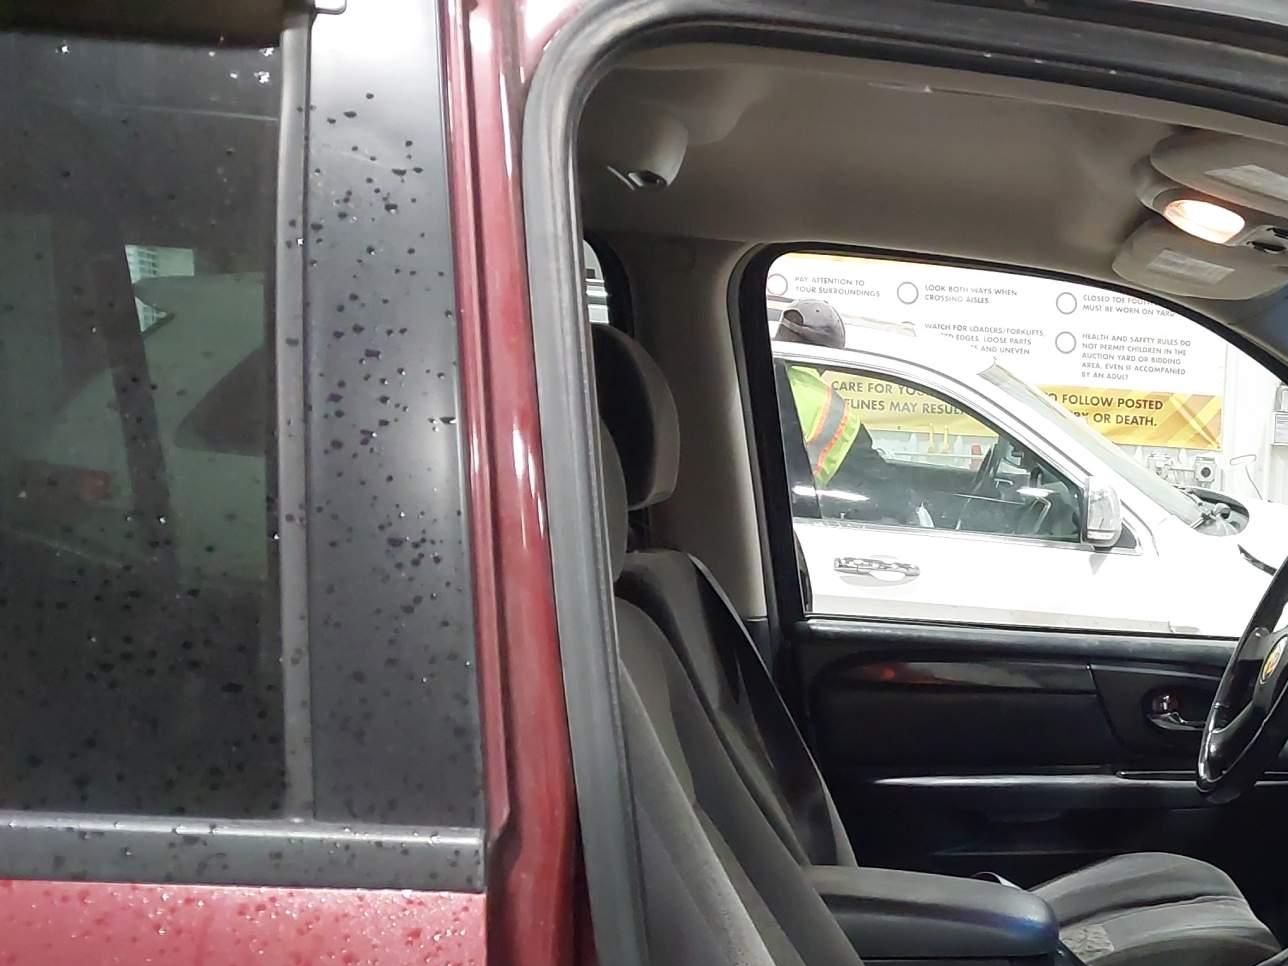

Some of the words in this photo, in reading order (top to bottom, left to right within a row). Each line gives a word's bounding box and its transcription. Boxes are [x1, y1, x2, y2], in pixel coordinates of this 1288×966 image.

[811, 277, 853, 286] ATTENTION
[818, 287, 881, 297] SURROUNDINGS
[924, 284, 946, 292] LOOK
[948, 285, 969, 293] BOTH
[970, 287, 992, 295] WAYS
[994, 288, 1018, 296] WHEN
[924, 294, 963, 303] CROSSING
[1082, 294, 1110, 302] CLOSED
[1082, 304, 1102, 312] MUST
[1115, 306, 1140, 314] WORN
[924, 322, 951, 331] WATCH
[952, 324, 967, 332] FOR
[983, 336, 1008, 344] LOOSE
[1009, 337, 1032, 345] PARTS
[1082, 333, 1109, 341] HEALTH
[1130, 336, 1155, 344] SAFETY
[1157, 338, 1178, 346] RULES
[981, 345, 998, 353] AND
[1000, 346, 1030, 355] UNEVEN
[1100, 343, 1125, 351] PERMIT
[1127, 346, 1161, 354] CHILDREN
[1175, 348, 1187, 356] THE
[1082, 352, 1115, 360] AUCTION
[1117, 354, 1136, 362] YARD
[1151, 357, 1181, 365] BIDDING
[1105, 363, 1124, 371] EVEN
[1134, 365, 1186, 375] ACCOMPANIED
[831, 380, 863, 392] CARE
[868, 382, 893, 394] FOR
[889, 400, 918, 413] MAY
[1062, 393, 1114, 407] FOLLOW
[1117, 398, 1163, 410] POSTED
[1093, 412, 1111, 424] OR
[1115, 414, 1158, 427] DEATH.
